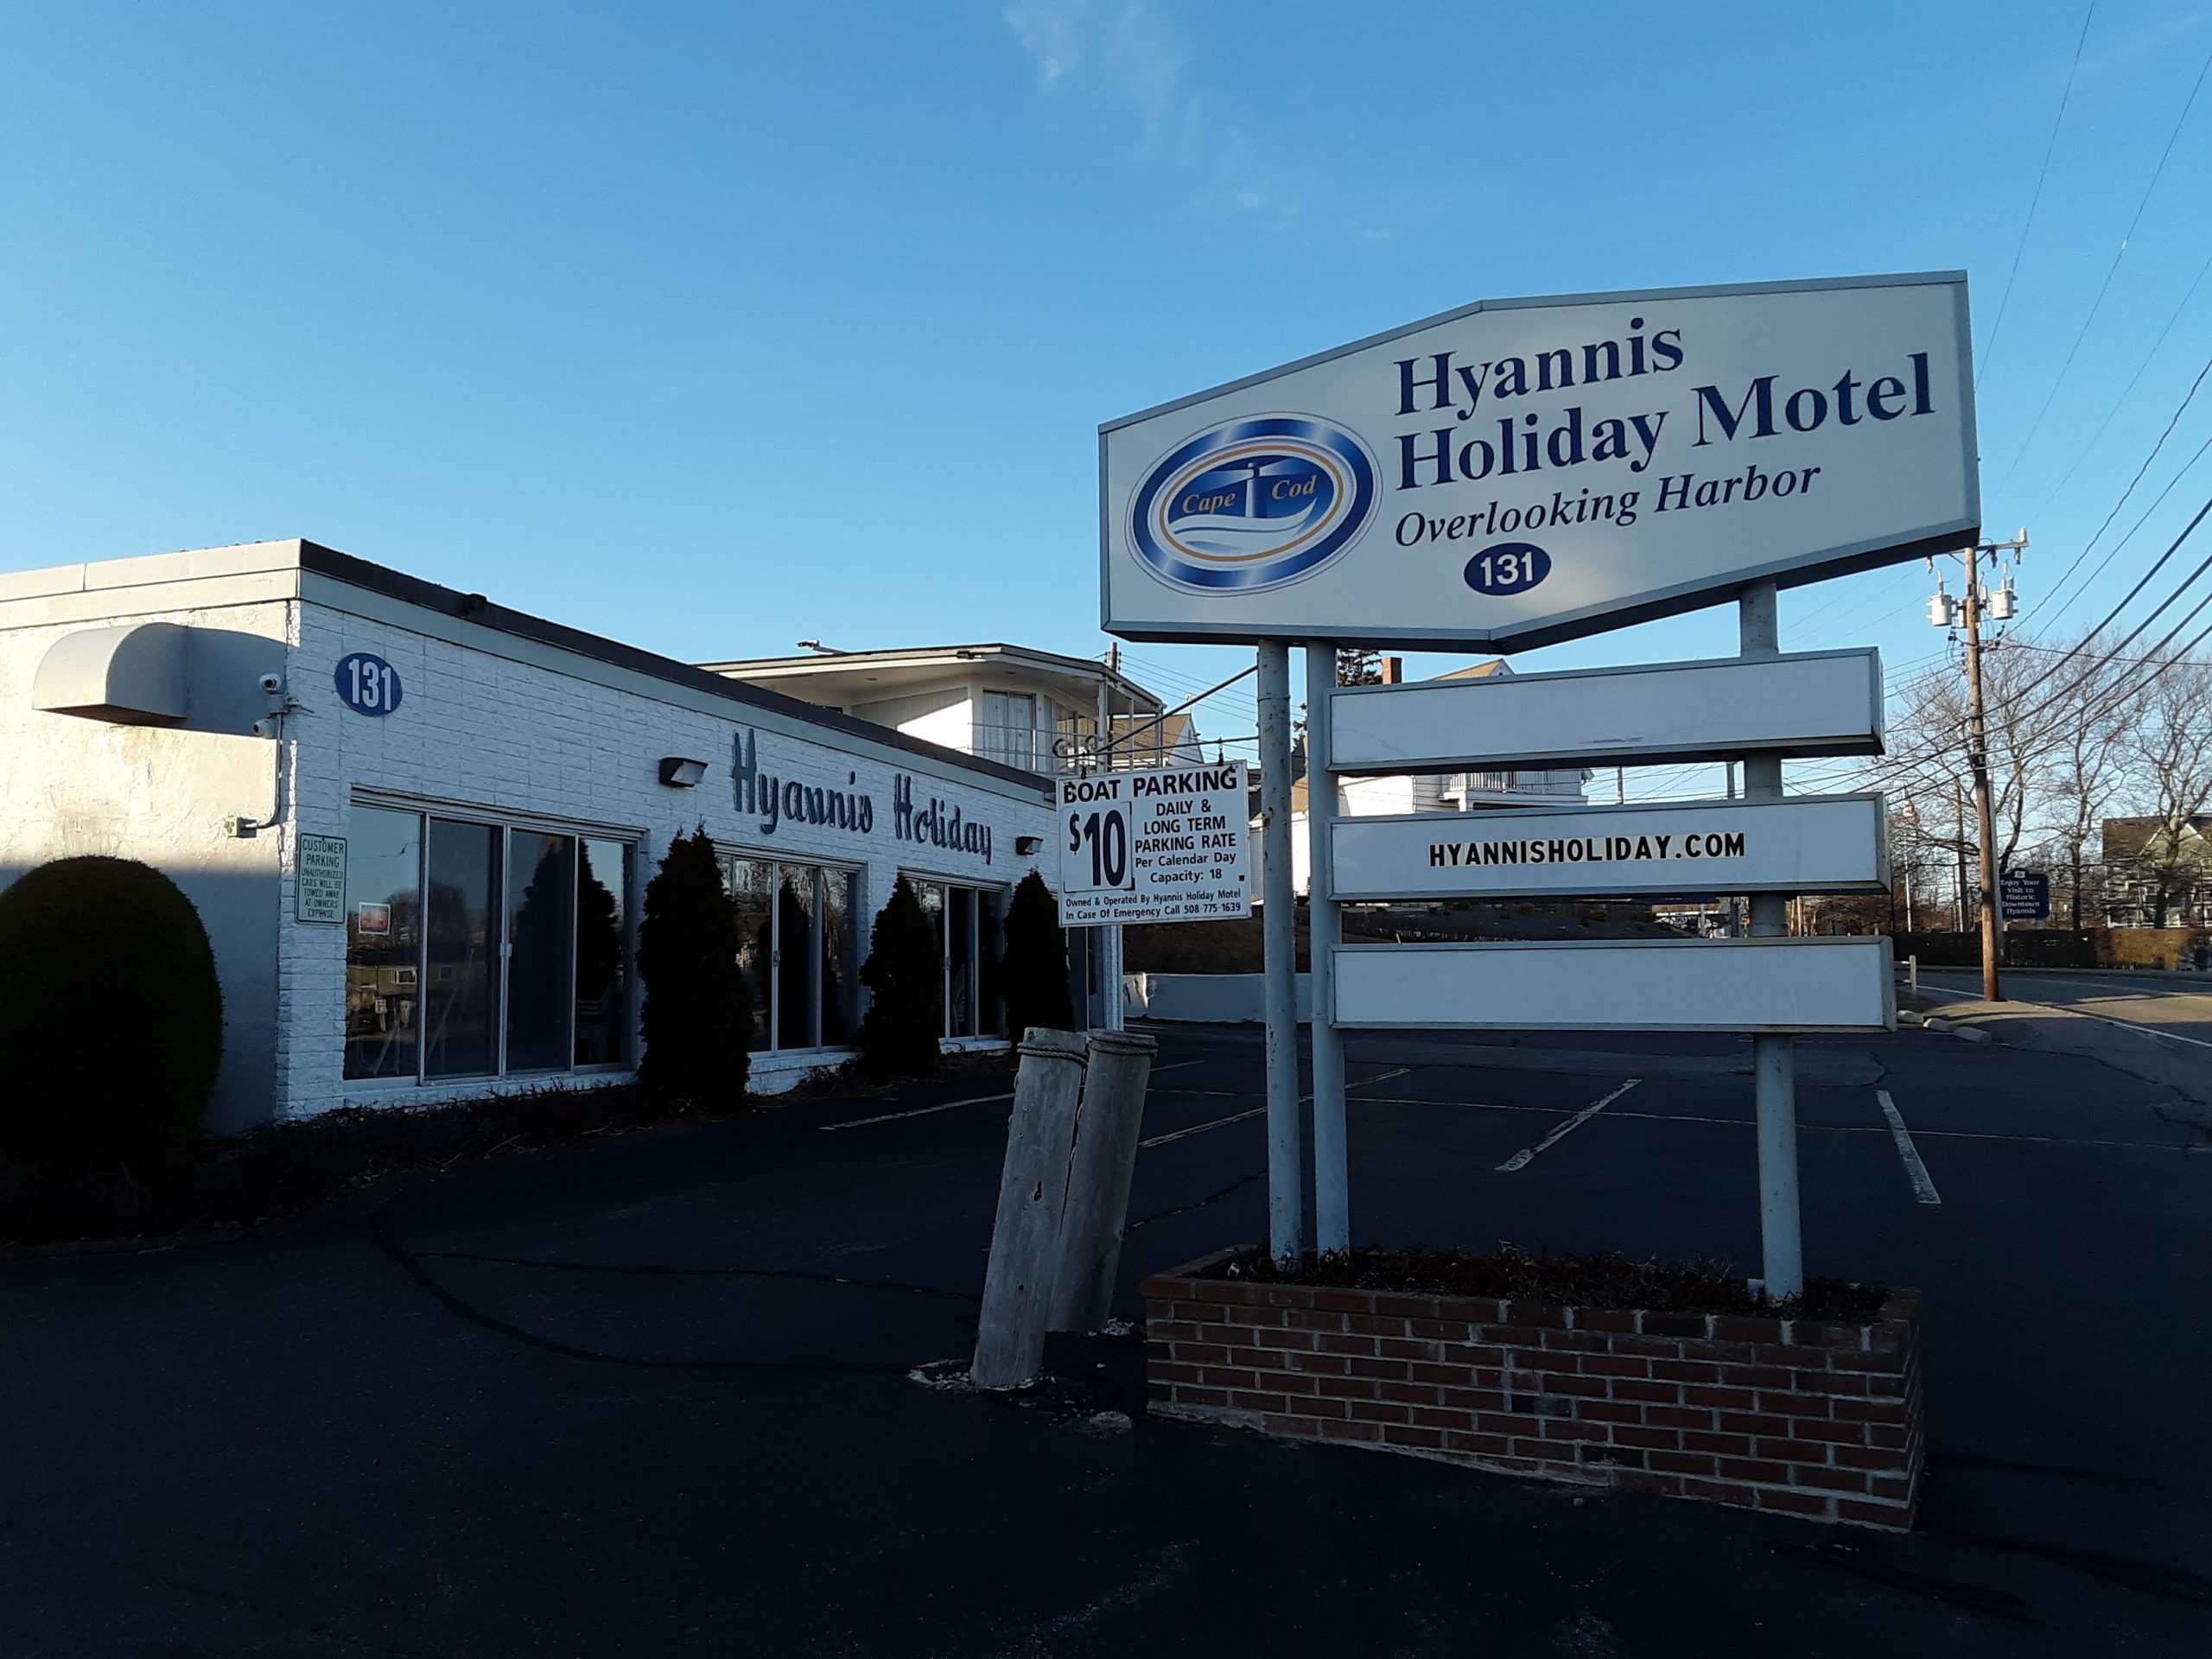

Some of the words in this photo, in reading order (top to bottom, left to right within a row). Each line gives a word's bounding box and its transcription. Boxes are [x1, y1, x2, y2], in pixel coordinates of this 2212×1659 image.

[1393, 317, 1684, 421] Hyannis
[1394, 407, 1669, 491] Holiday
[1690, 352, 1936, 448] Motel
[1182, 493, 1236, 515] Cape
[1272, 474, 1318, 500] Cod
[1395, 486, 1640, 546] Overlooking
[1653, 464, 1821, 514] Harbor
[1478, 550, 1535, 588] 131
[348, 658, 391, 711] 131
[731, 728, 873, 835] Hyannis
[894, 772, 991, 865] Holiday
[1063, 779, 1121, 804] BOAT
[1133, 766, 1237, 798] PARKING
[1156, 800, 1193, 817] DAILY
[1201, 798, 1211, 813] &
[1144, 818, 1180, 835] LONG
[1187, 816, 1226, 832] TERM
[302, 839, 344, 855] CUSTOMER
[1069, 809, 1126, 887] $10
[1135, 836, 1194, 853] PARKING
[1202, 833, 1236, 849] RATE
[1135, 857, 1153, 868] Per
[1158, 853, 1209, 867] Calendar
[1214, 851, 1236, 865] Day
[1429, 833, 1745, 867] HYANNISHOLIDAY.COM
[306, 854, 340, 868] PARKING
[1150, 869, 1205, 885] Capacity:
[1210, 868, 1223, 880] 18
[1065, 898, 1091, 907] Owned
[1095, 897, 1100, 906] &
[1103, 894, 1137, 906] Operated
[1141, 894, 1150, 905] By
[1154, 892, 1183, 905] Hyannis
[1186, 890, 1214, 901] Holiday
[1217, 888, 1241, 899] Motel
[1066, 912, 1074, 920] In
[1077, 910, 1096, 919] Case
[1100, 909, 1110, 918] Of
[1114, 907, 1160, 919] Emergency
[1164, 905, 1180, 915] Call
[1184, 902, 1241, 914] 508-775-1639
